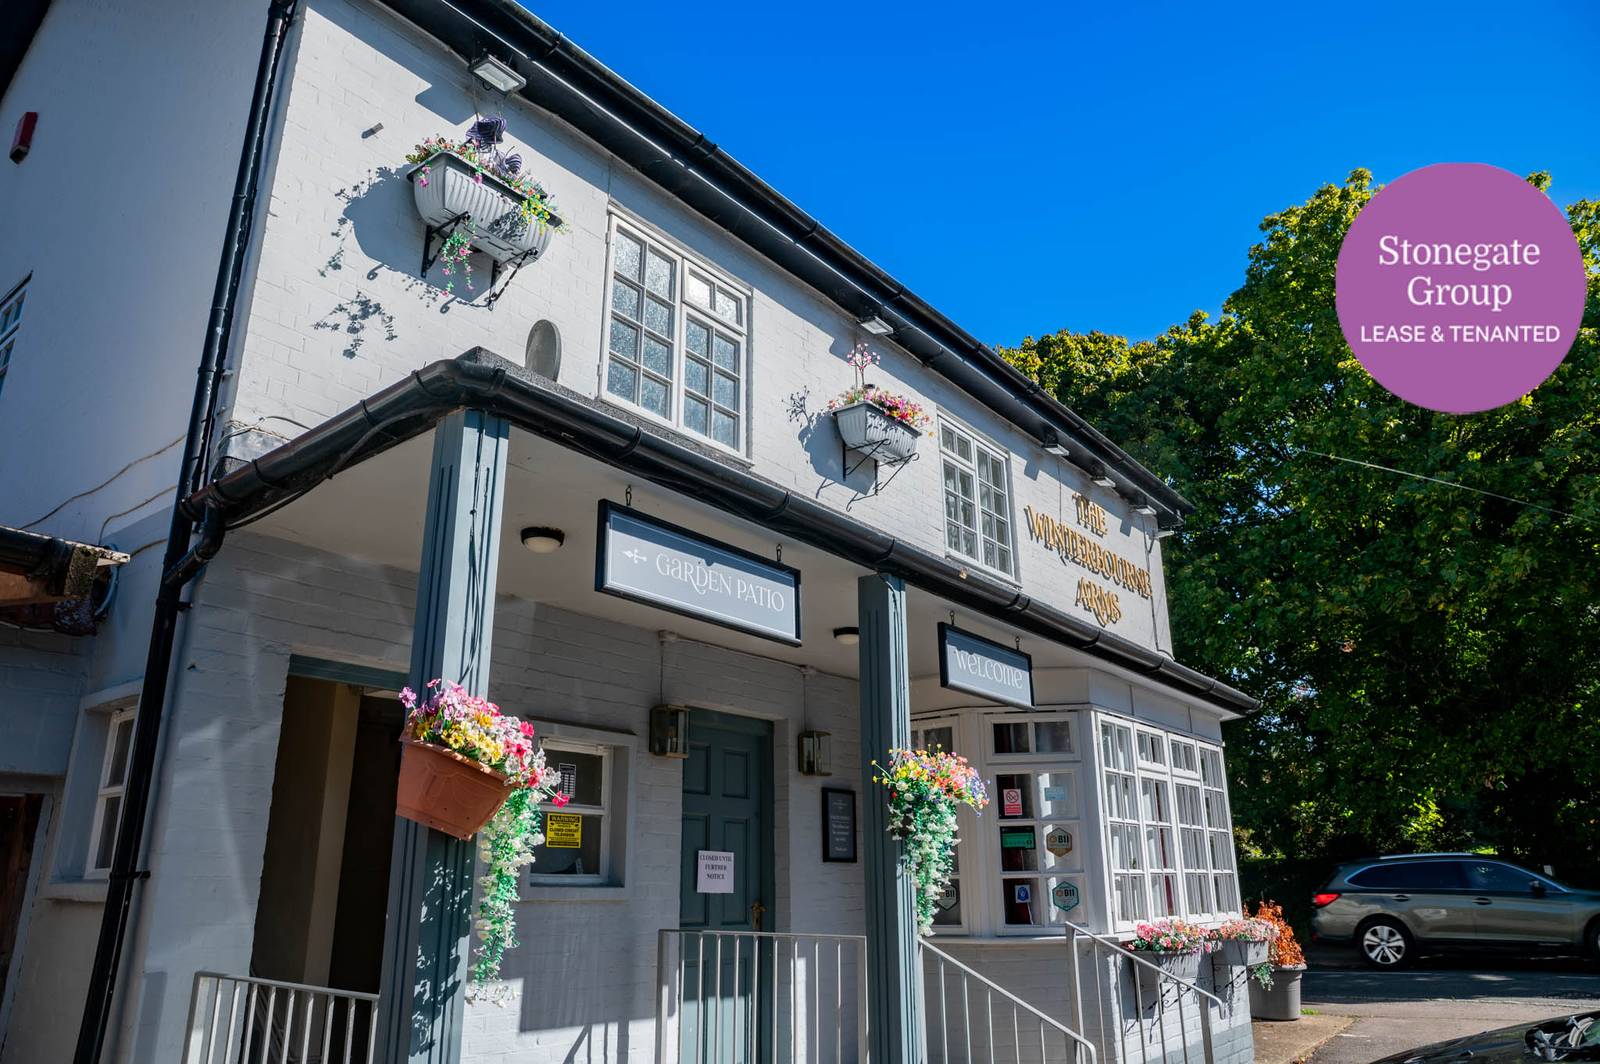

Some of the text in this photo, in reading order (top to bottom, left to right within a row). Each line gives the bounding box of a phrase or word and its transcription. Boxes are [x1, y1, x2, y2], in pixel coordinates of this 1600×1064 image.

[1072, 492, 1108, 537] THE
[1024, 504, 1152, 599] WINTERBOURNE
[737, 579, 785, 612] PATIO
[1076, 576, 1121, 627] ARMS
